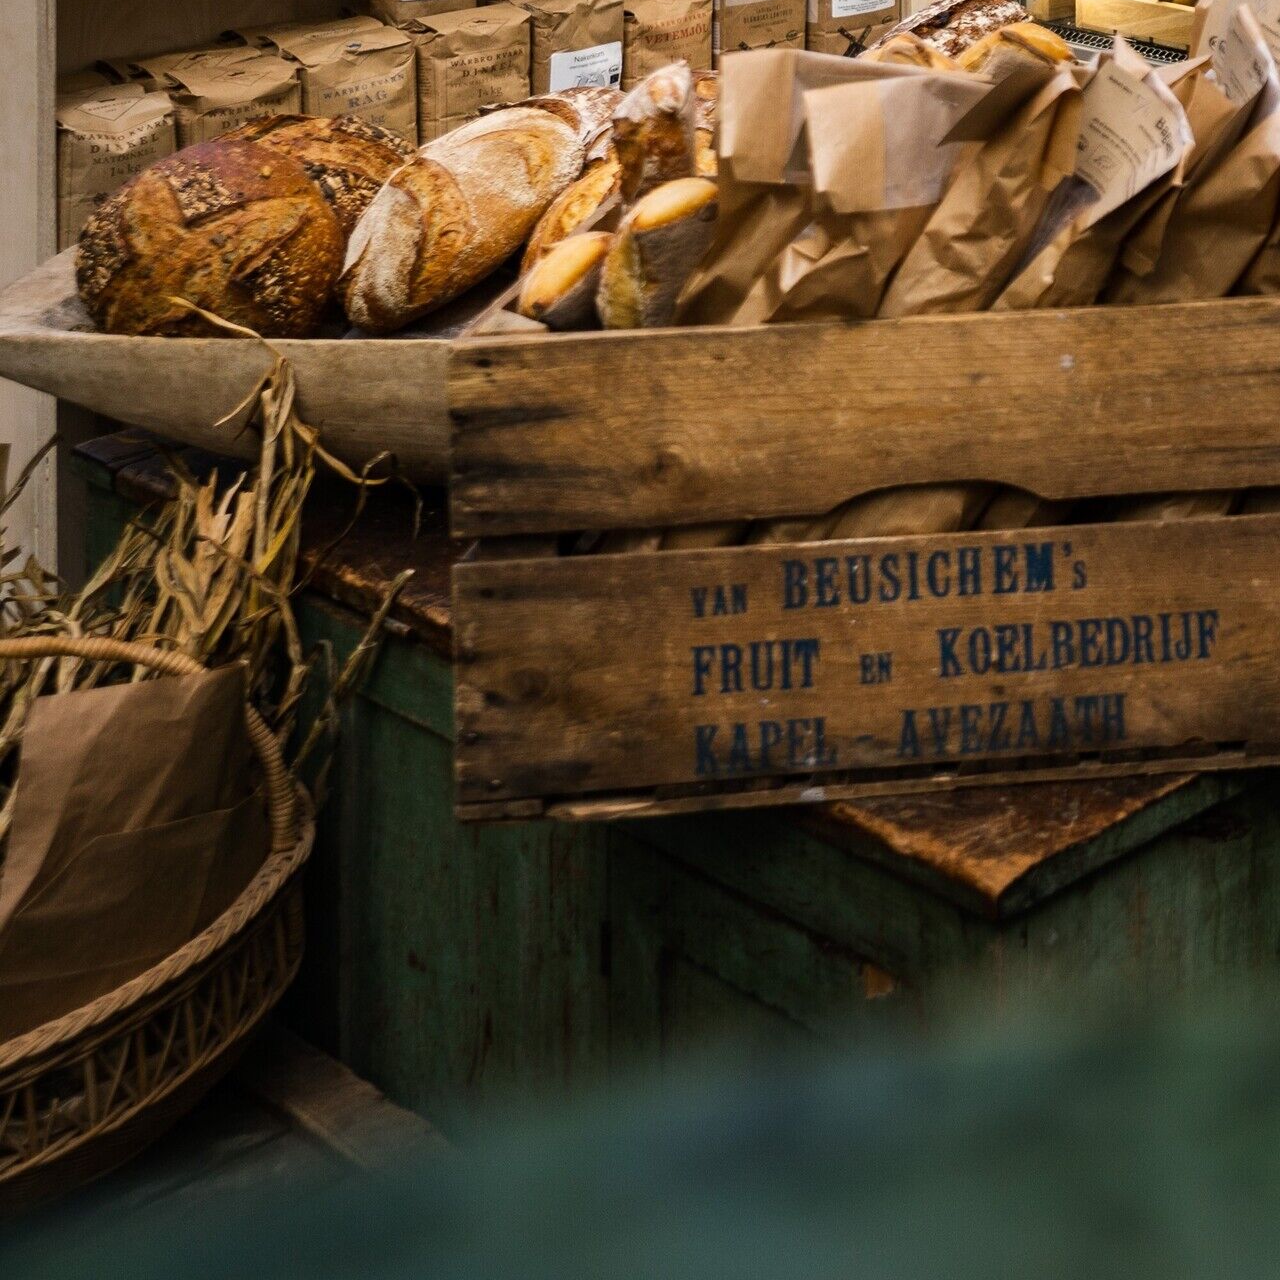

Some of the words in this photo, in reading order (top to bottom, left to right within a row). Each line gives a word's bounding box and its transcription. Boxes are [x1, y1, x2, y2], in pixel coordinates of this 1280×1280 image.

[645, 23, 709, 45] VETEMJÖL
[450, 54, 493, 68] WARBRO
[496, 47, 525, 61] KVARN
[90, 133, 160, 154] DINKEL
[690, 583, 747, 619] VAN
[690, 636, 821, 696] FRUIT
[858, 651, 895, 685] EN
[936, 608, 1220, 680] KOELBEDRIJF
[693, 717, 838, 776] KAPEL
[896, 692, 1129, 760] AVEZAATH
